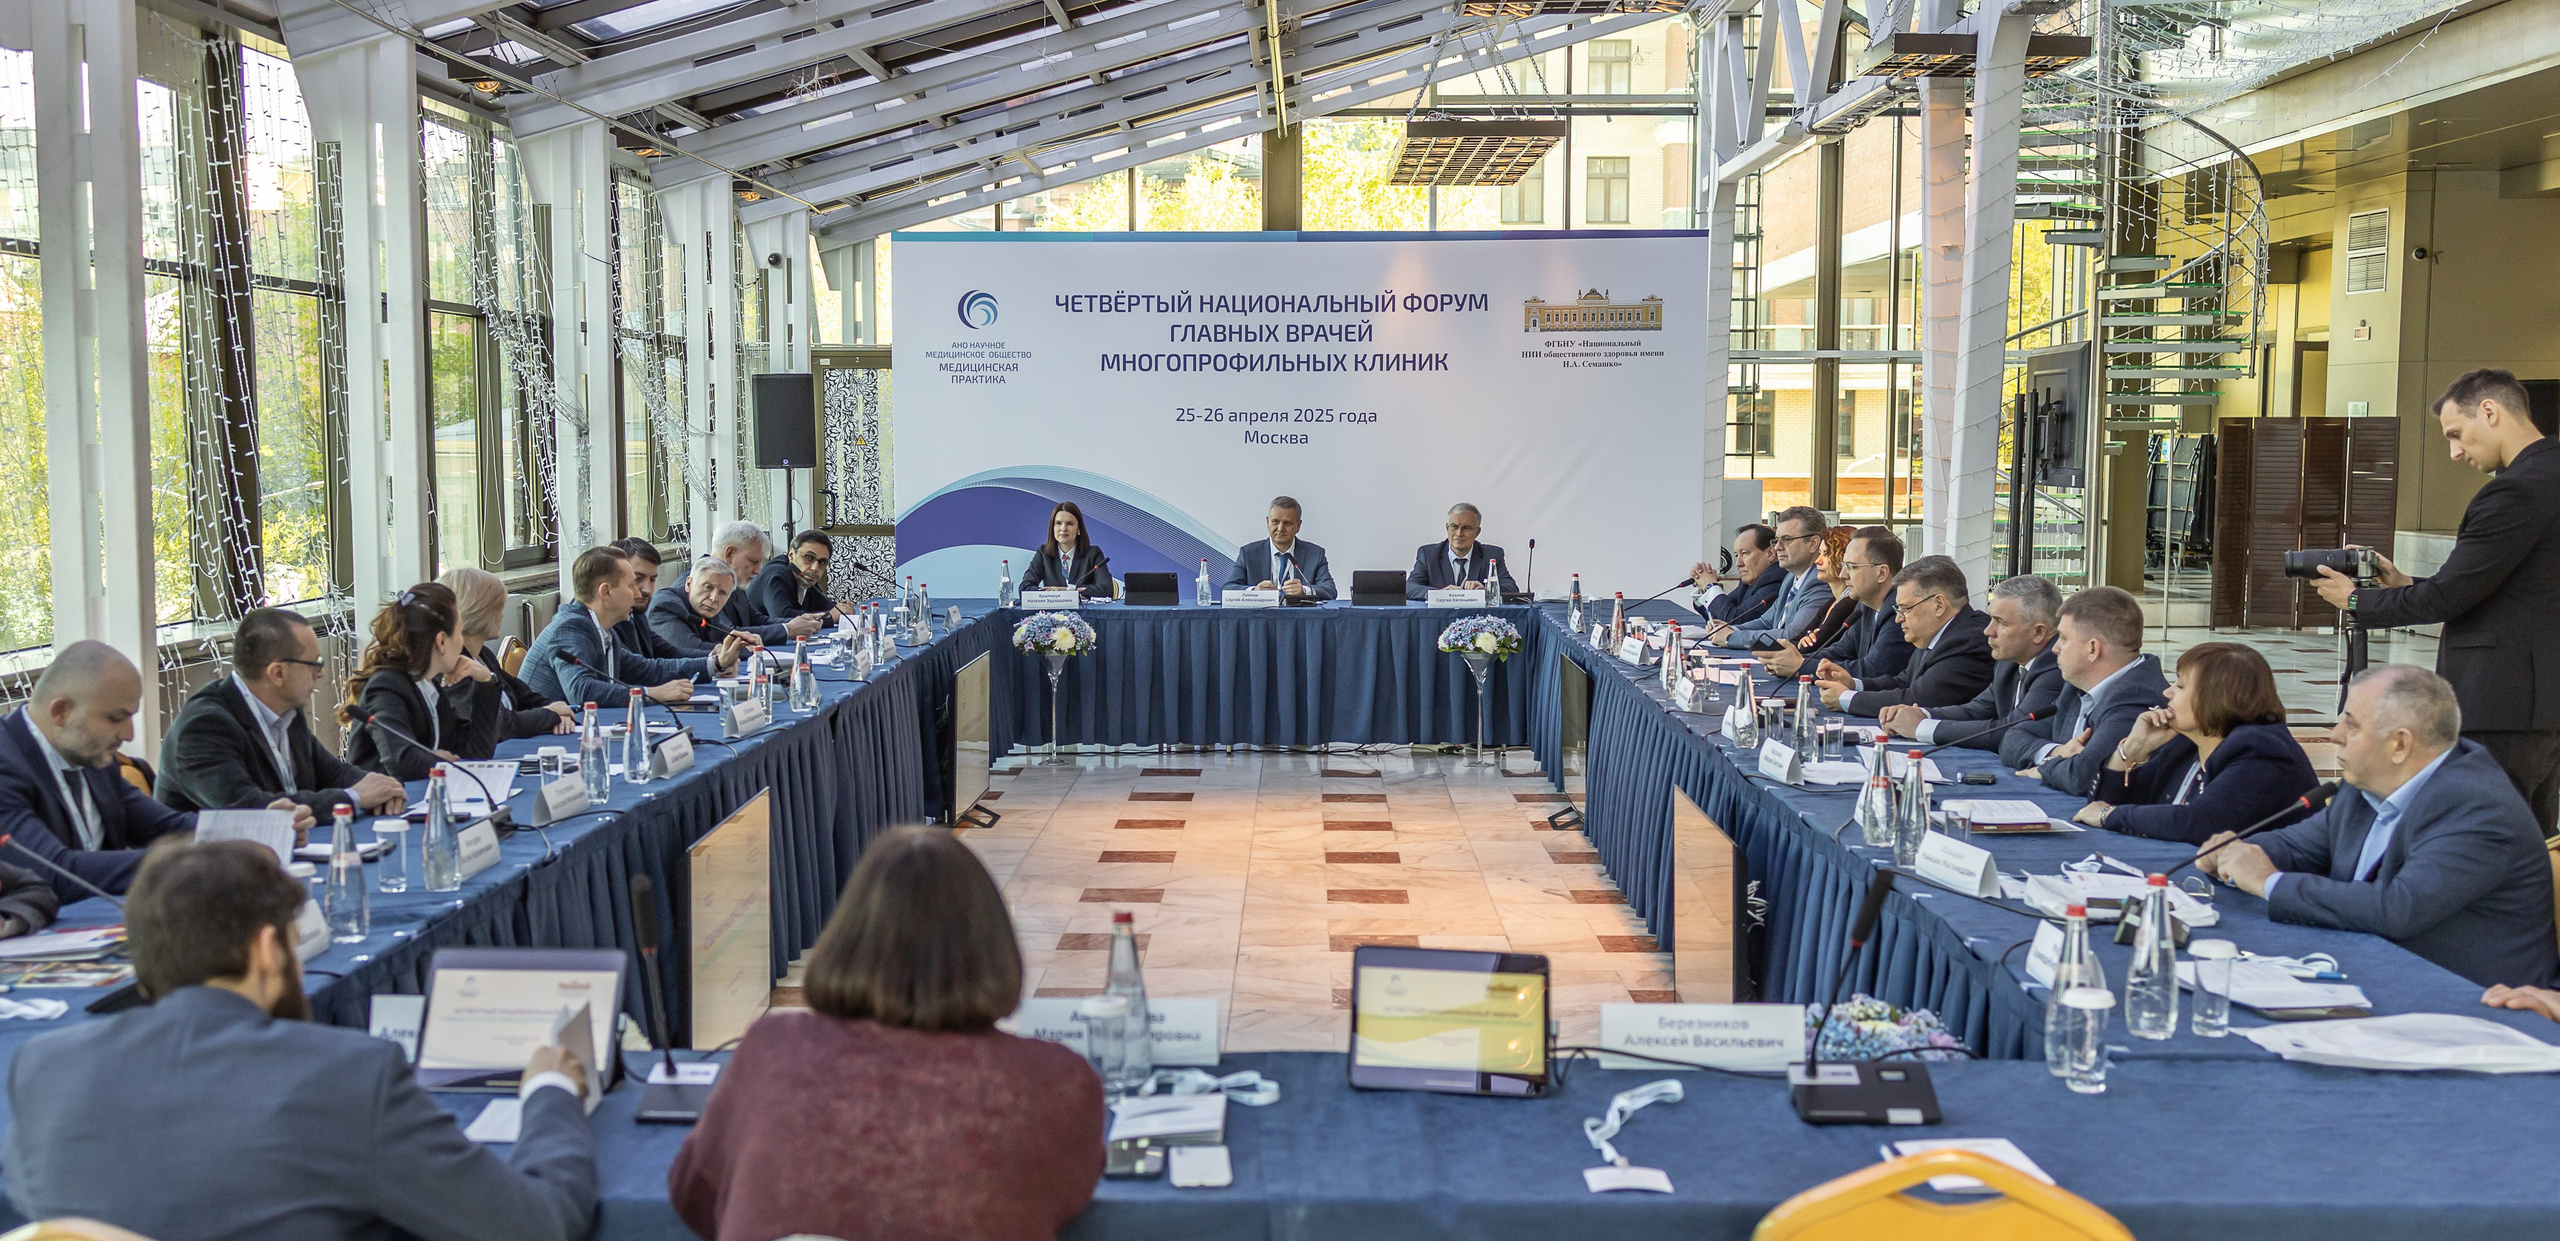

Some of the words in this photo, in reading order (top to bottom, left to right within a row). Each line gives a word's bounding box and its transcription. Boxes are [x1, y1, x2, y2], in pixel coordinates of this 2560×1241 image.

[1055, 290, 1192, 314] ЧЕТВЁРТЫЙ
[1200, 289, 1396, 316] НАЦИОНАЛЬНЫЙ
[1402, 292, 1489, 314] ФОРУМ
[1170, 324, 1280, 343] ГЛАВНЫХ
[1286, 319, 1373, 343] ВРАЧЕЙ
[951, 341, 968, 349] АНО
[970, 341, 1006, 349] НАУЧНОЕ
[1544, 340, 1576, 348] ФГБНУ
[1578, 339, 1642, 349] «Национальный
[925, 351, 985, 359] МЕДИЦИНСКОЕ
[988, 351, 1032, 359] ОБЩЕСТВО
[1543, 350, 1602, 359] общественного
[1603, 351, 1638, 359] здоровья
[939, 362, 1019, 373] МЕДИЦИНСКАЯ
[1100, 352, 1348, 373] МНОГОПРОФИЛЬНЫХ
[1354, 352, 1449, 372] КЛИНИК
[1582, 360, 1623, 368] Семашко»
[951, 375, 1007, 384] ПРАКТИКА
[1175, 407, 1224, 423] 25-26
[1228, 411, 1289, 426] апреля
[1293, 408, 1335, 423] 2025
[1339, 411, 1378, 426] года
[1244, 430, 1309, 445] Москва
[1658, 1016, 1750, 1030] Березников
[1624, 1034, 1689, 1047] Алексей
[1693, 1034, 1784, 1049] Васильевич
